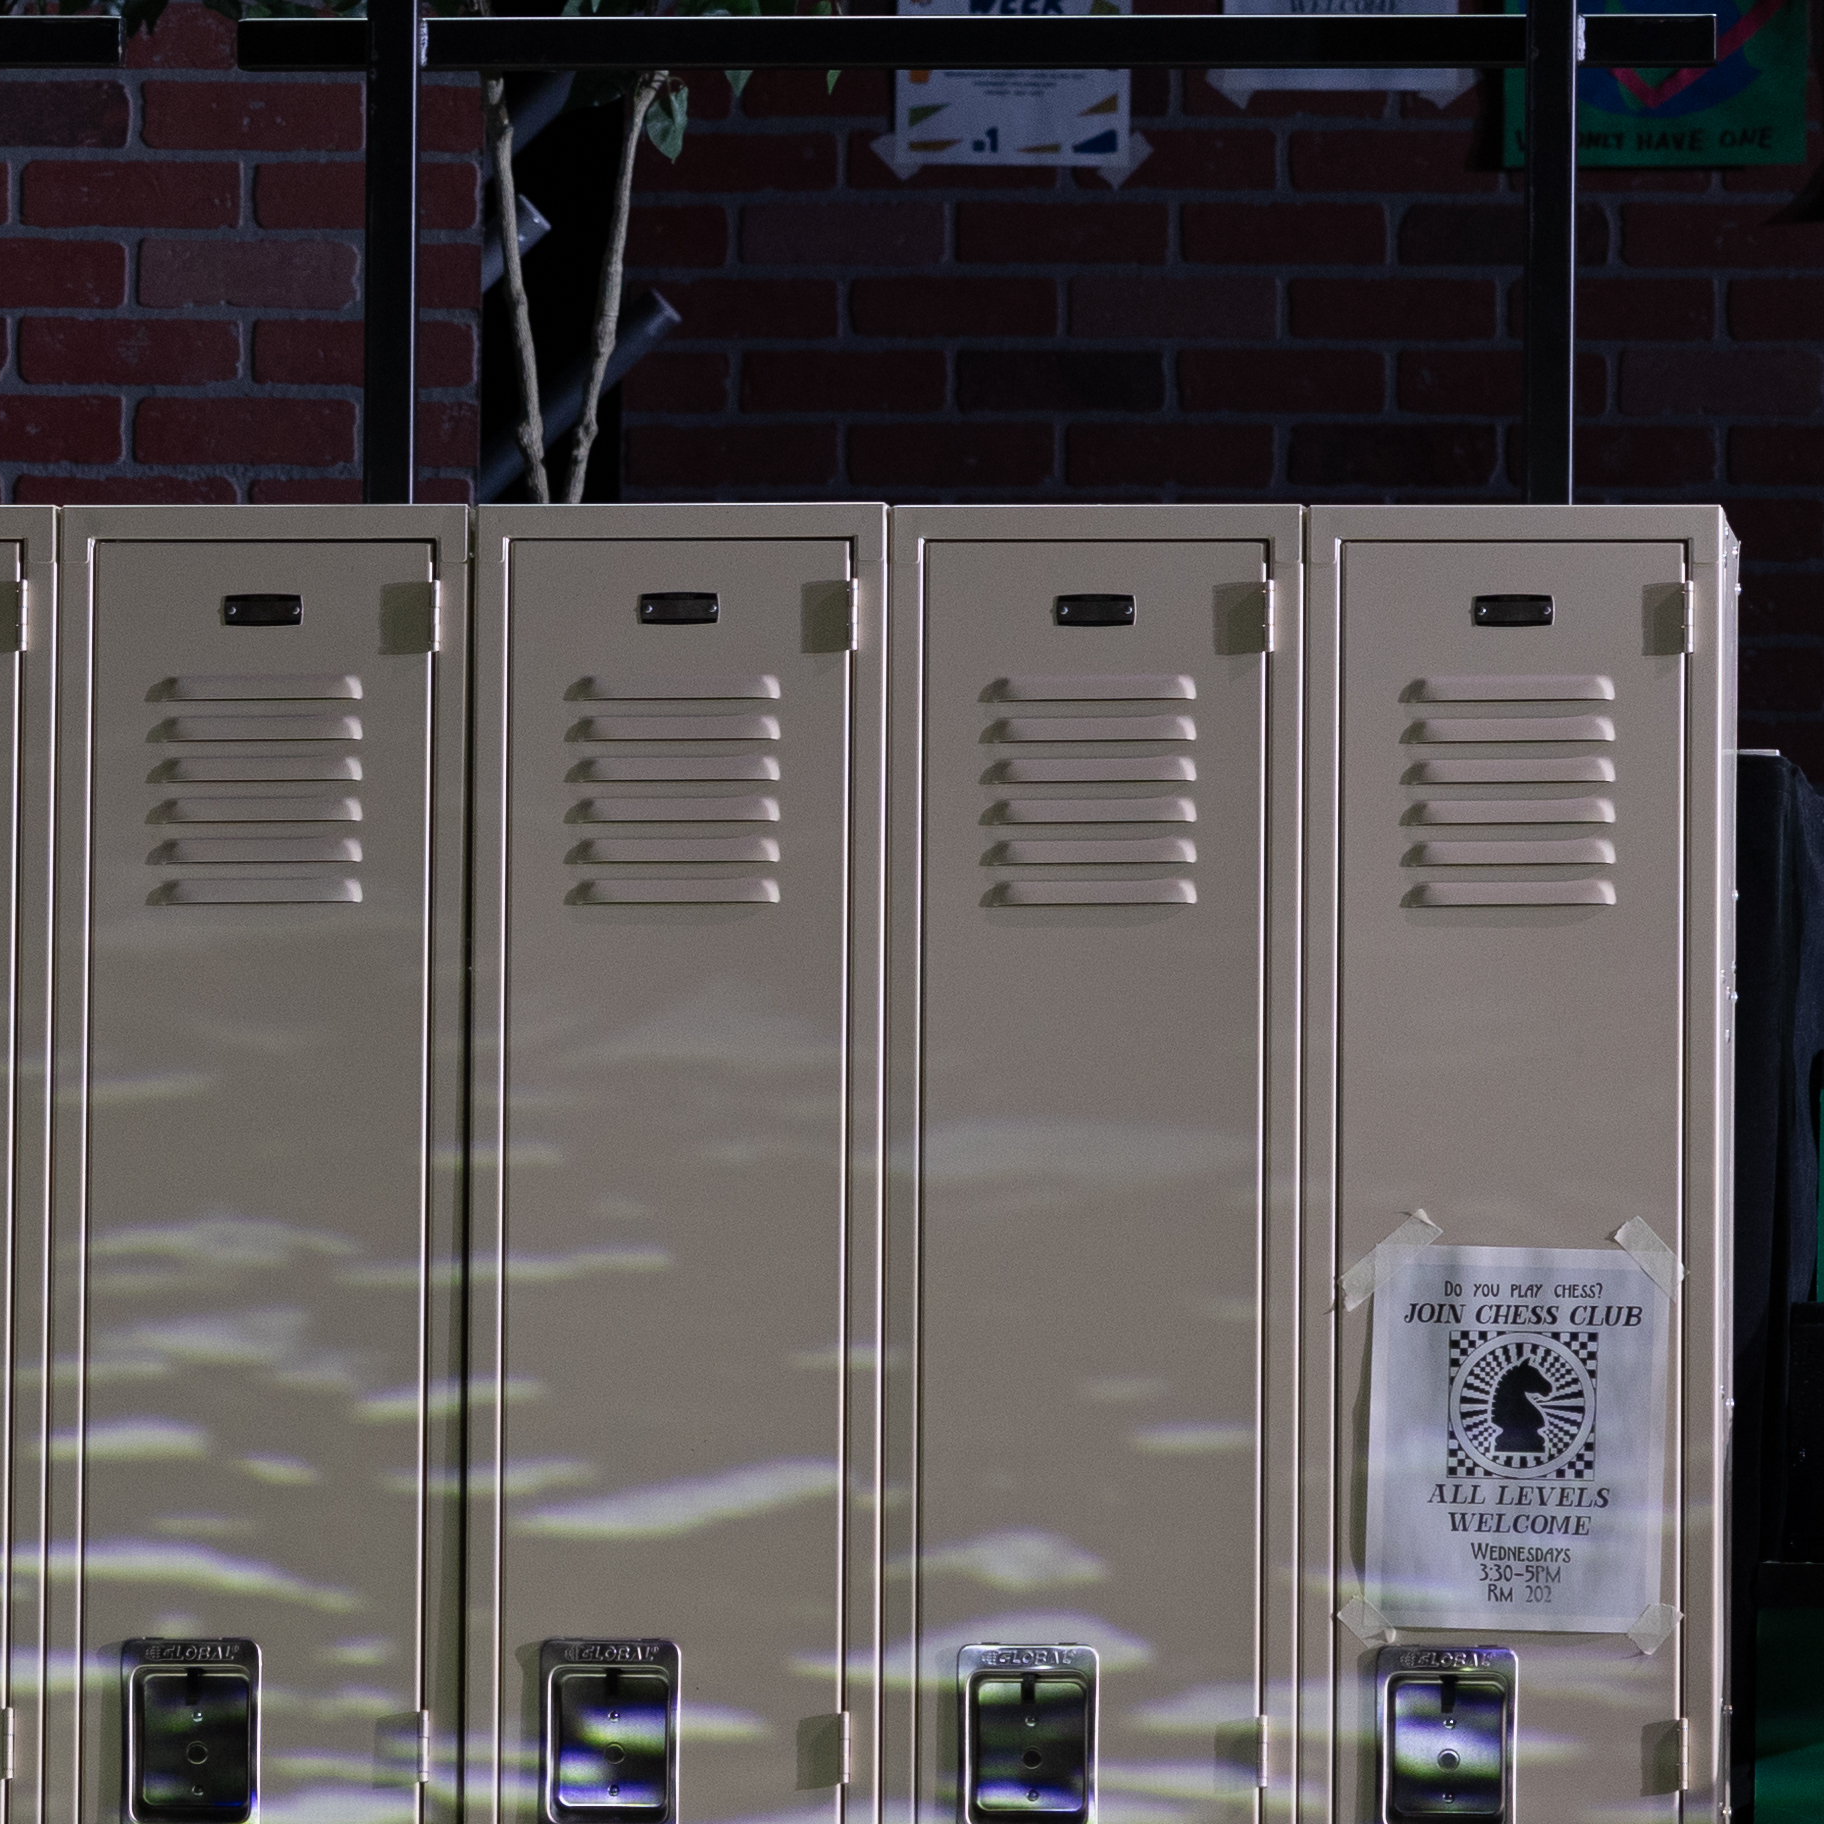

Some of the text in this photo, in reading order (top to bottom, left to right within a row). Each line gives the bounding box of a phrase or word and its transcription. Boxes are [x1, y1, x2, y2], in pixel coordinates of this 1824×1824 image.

[1636, 126, 1704, 151] HAVE
[1719, 125, 1773, 150] ONE
[1474, 1283, 1500, 1298] YOU
[1510, 1283, 1543, 1298] PLAY
[1554, 1282, 1604, 1299] CHESS?
[1403, 1302, 1643, 1327] JOIN CHESS CLUB
[1427, 1483, 1611, 1509] ALL LEVELS
[1448, 1511, 1592, 1536] WELCOME
[1470, 1542, 1571, 1563] WEDNESDAYS
[1525, 1585, 1552, 1603] 202
